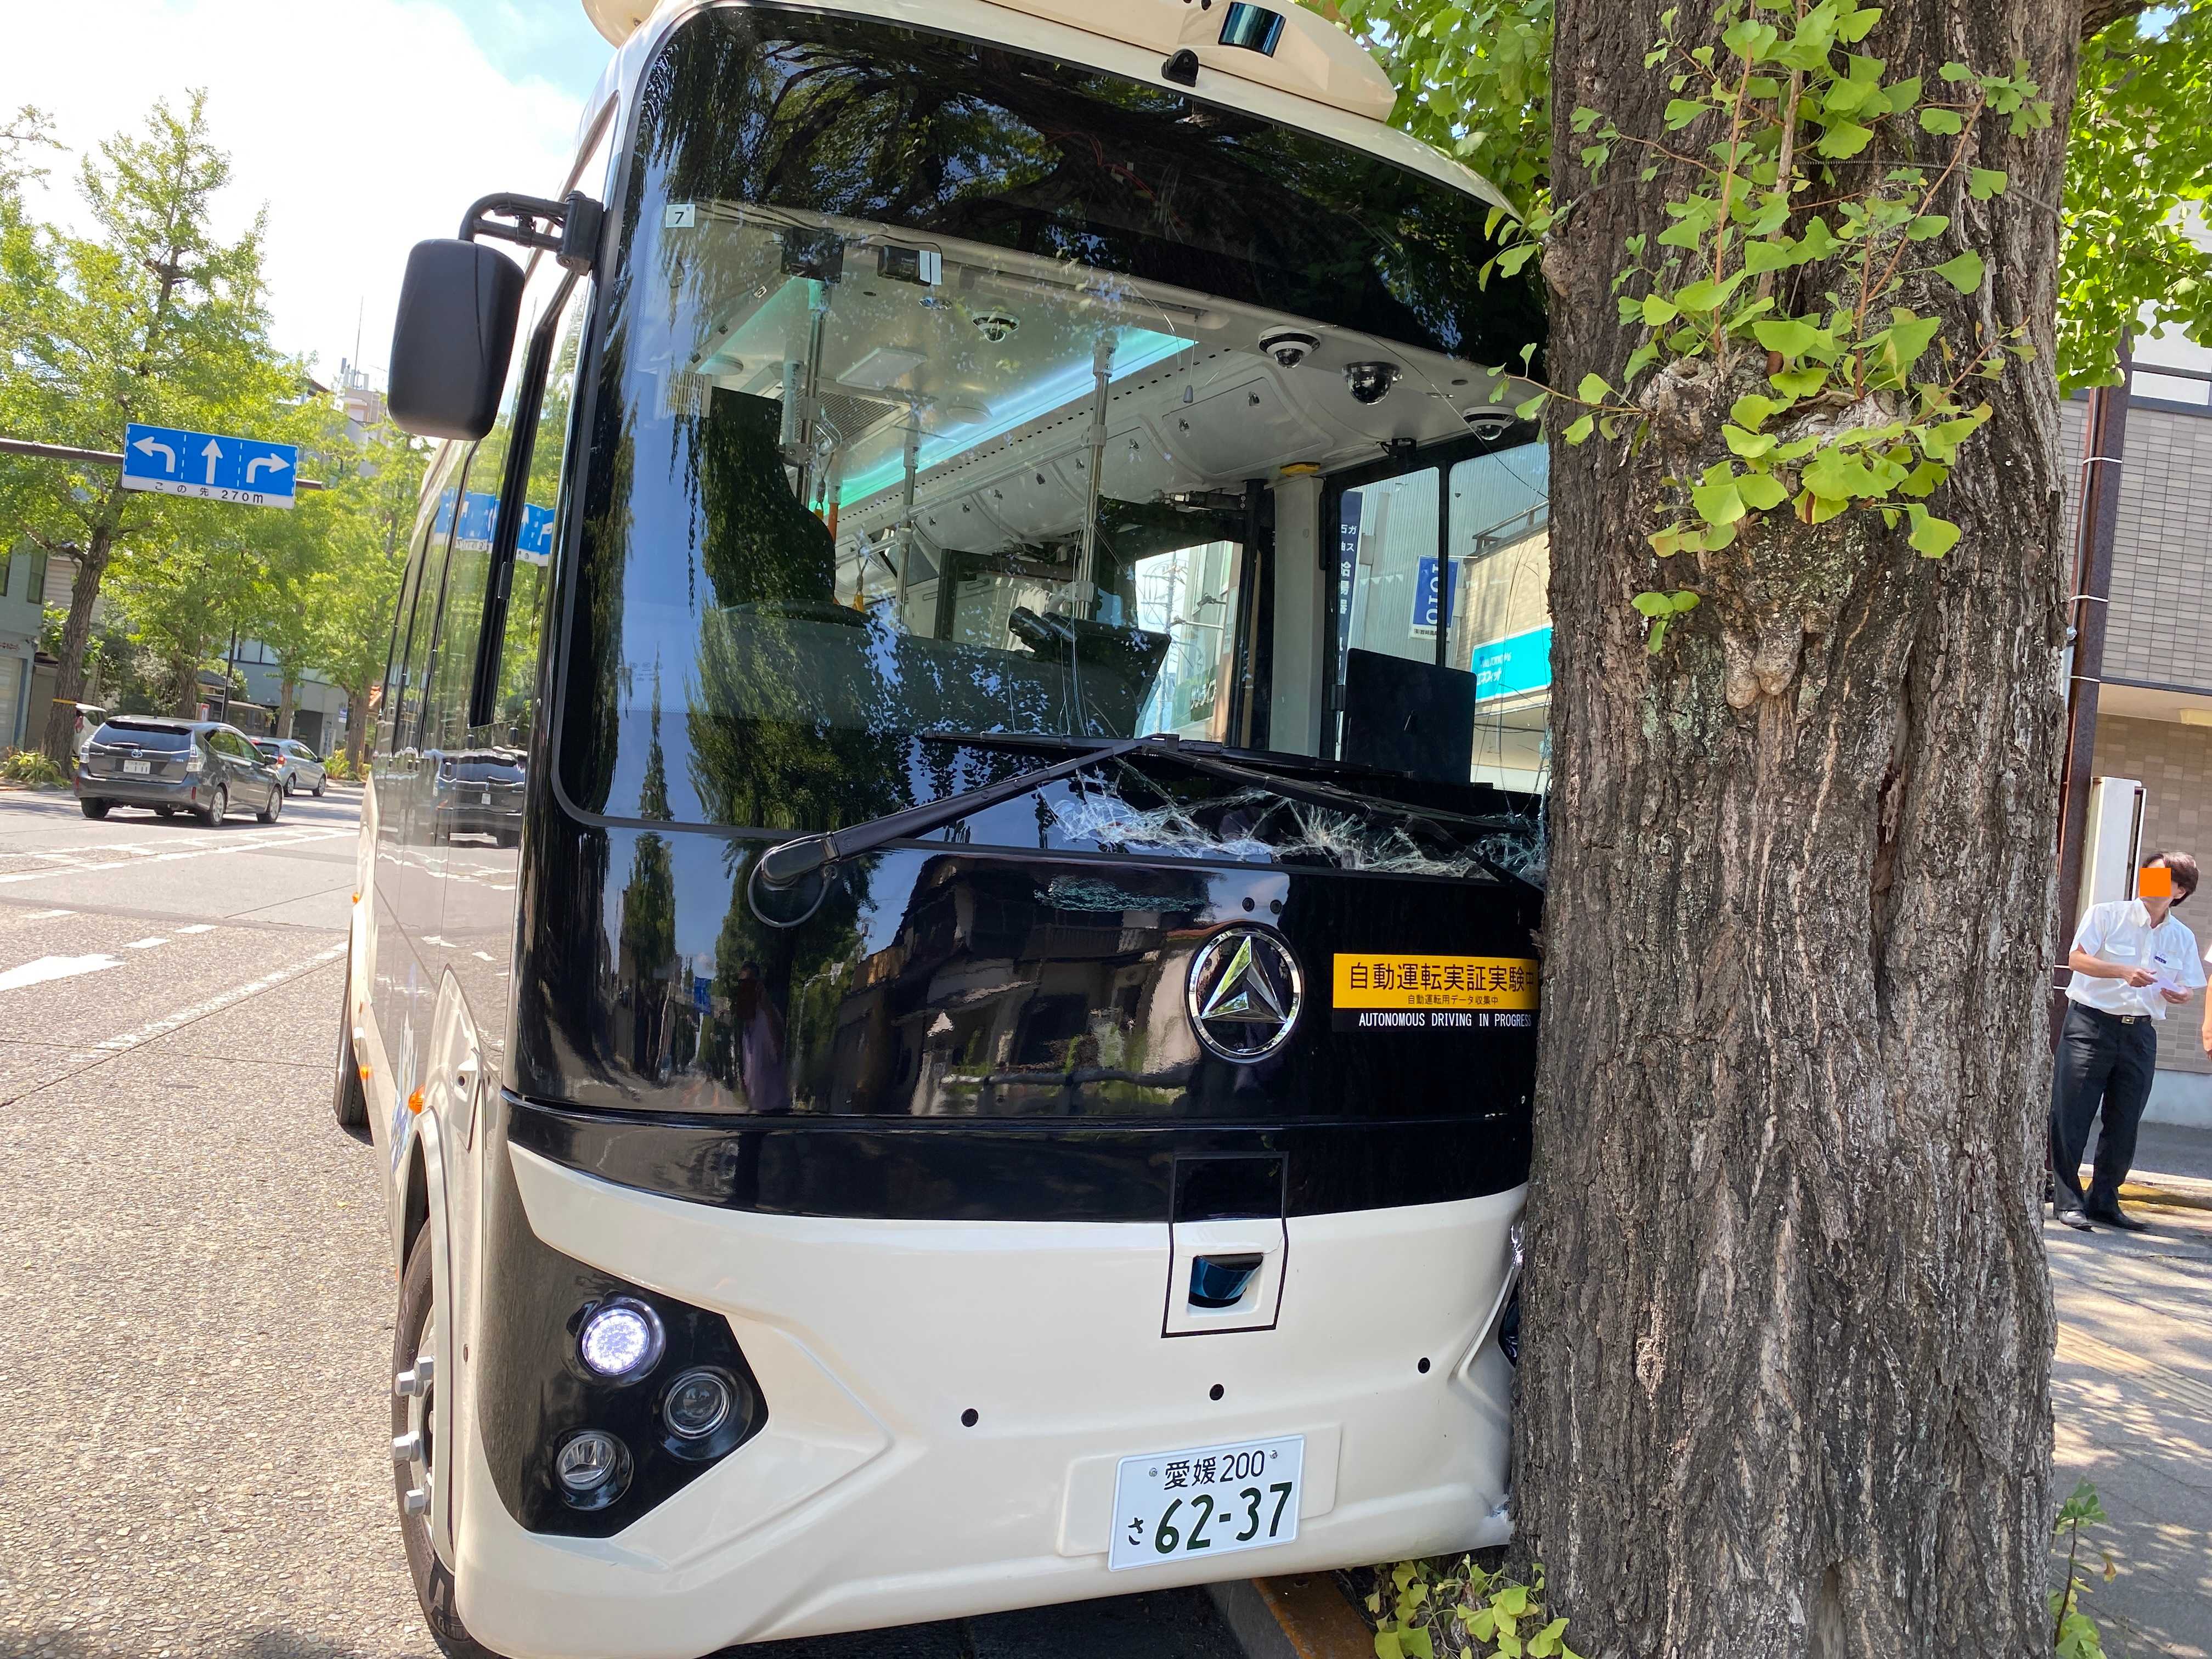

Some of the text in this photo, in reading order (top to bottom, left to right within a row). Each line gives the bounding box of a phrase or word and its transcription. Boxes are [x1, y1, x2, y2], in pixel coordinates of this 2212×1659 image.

[675, 211, 685, 224] 7
[155, 482, 264, 504] この先 270m
[1350, 962, 1534, 992] 自動運転実証実験中
[1408, 994, 1499, 1006] 自動運転用データ収集中
[1358, 1012, 1532, 1027] AUTONOMOUS DRIVING IN PROGRESS
[1127, 1481, 1293, 1554] さ 62-37
